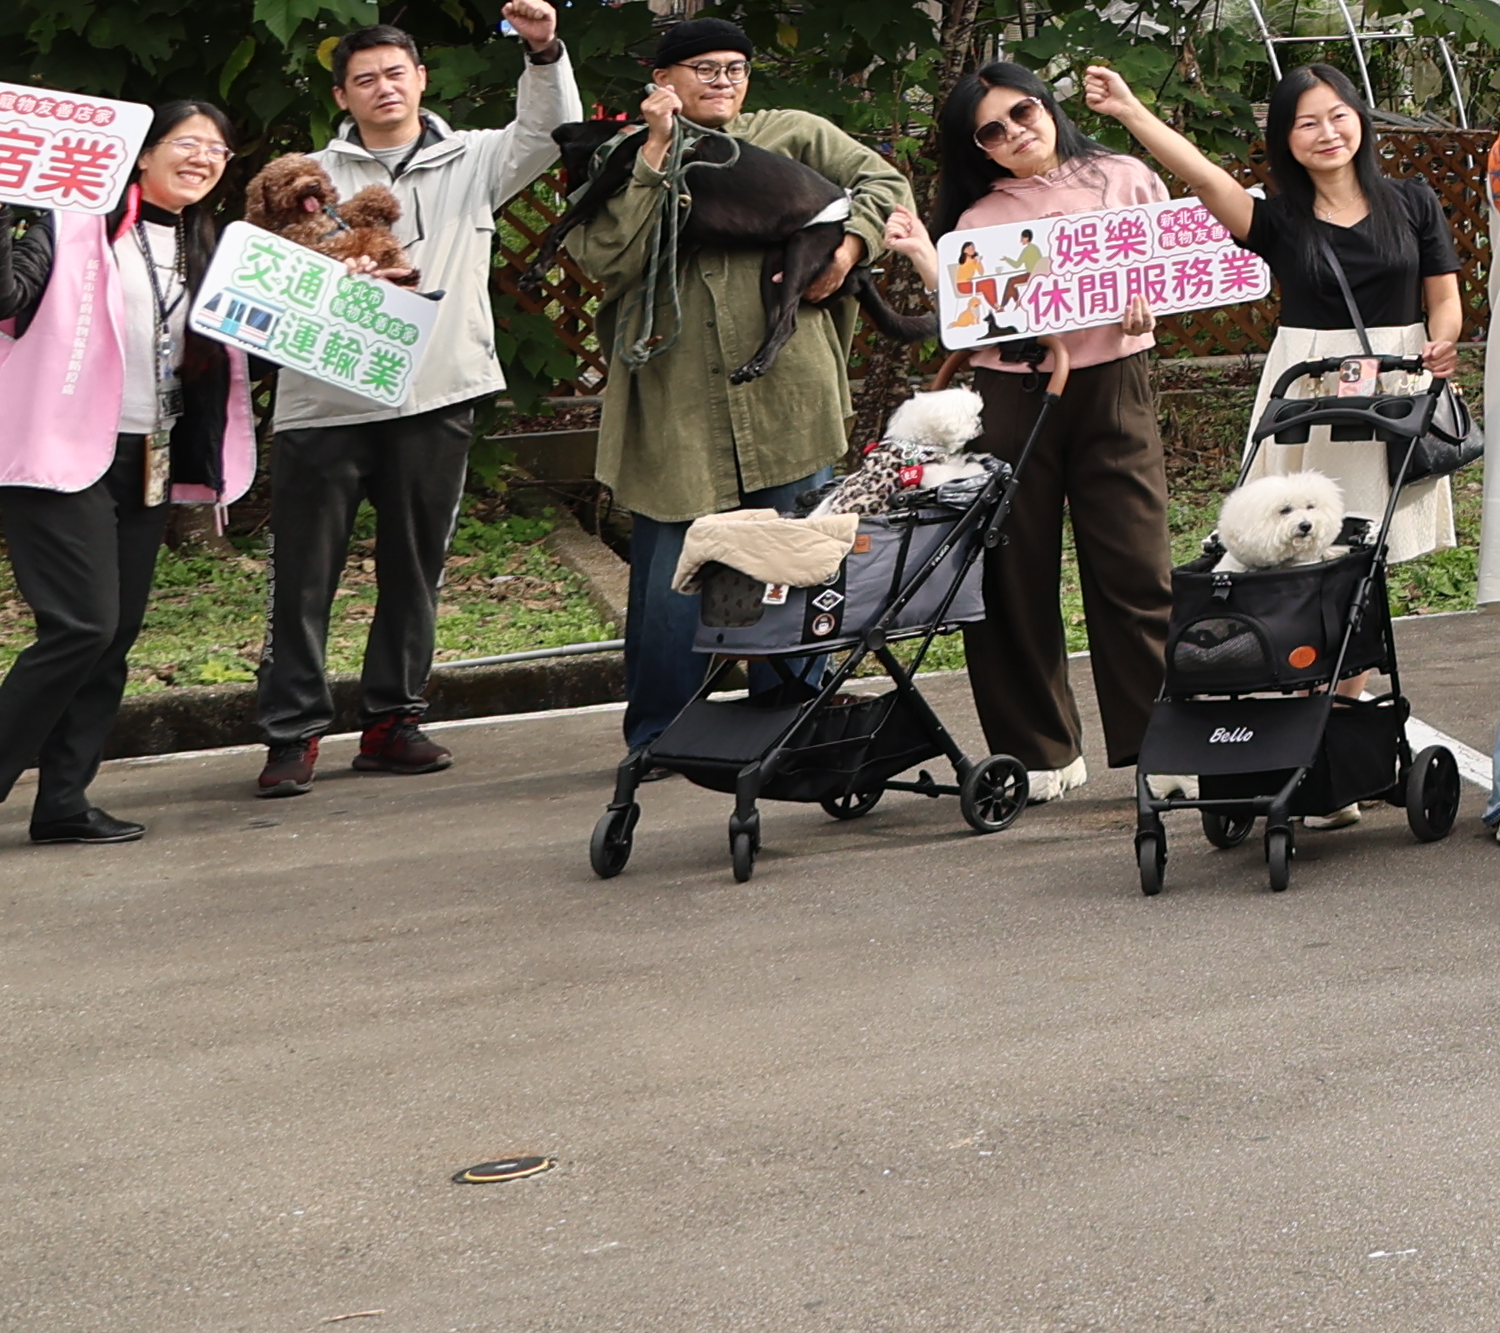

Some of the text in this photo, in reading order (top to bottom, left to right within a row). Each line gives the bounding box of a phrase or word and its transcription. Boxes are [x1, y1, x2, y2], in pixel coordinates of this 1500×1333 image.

[0, 93, 114, 124] 寵物友善店家
[1160, 208, 1208, 228] 新北市
[1161, 225, 1232, 249] 寵物友善
[1054, 214, 1147, 270] 娛樂
[238, 241, 329, 310] 交通
[339, 277, 384, 305] 新北市
[1027, 248, 1262, 325] 休閒服務業
[331, 299, 418, 344] 寵物友善店家
[273, 311, 407, 397] 運輸業
[1209, 726, 1254, 744] Bello
